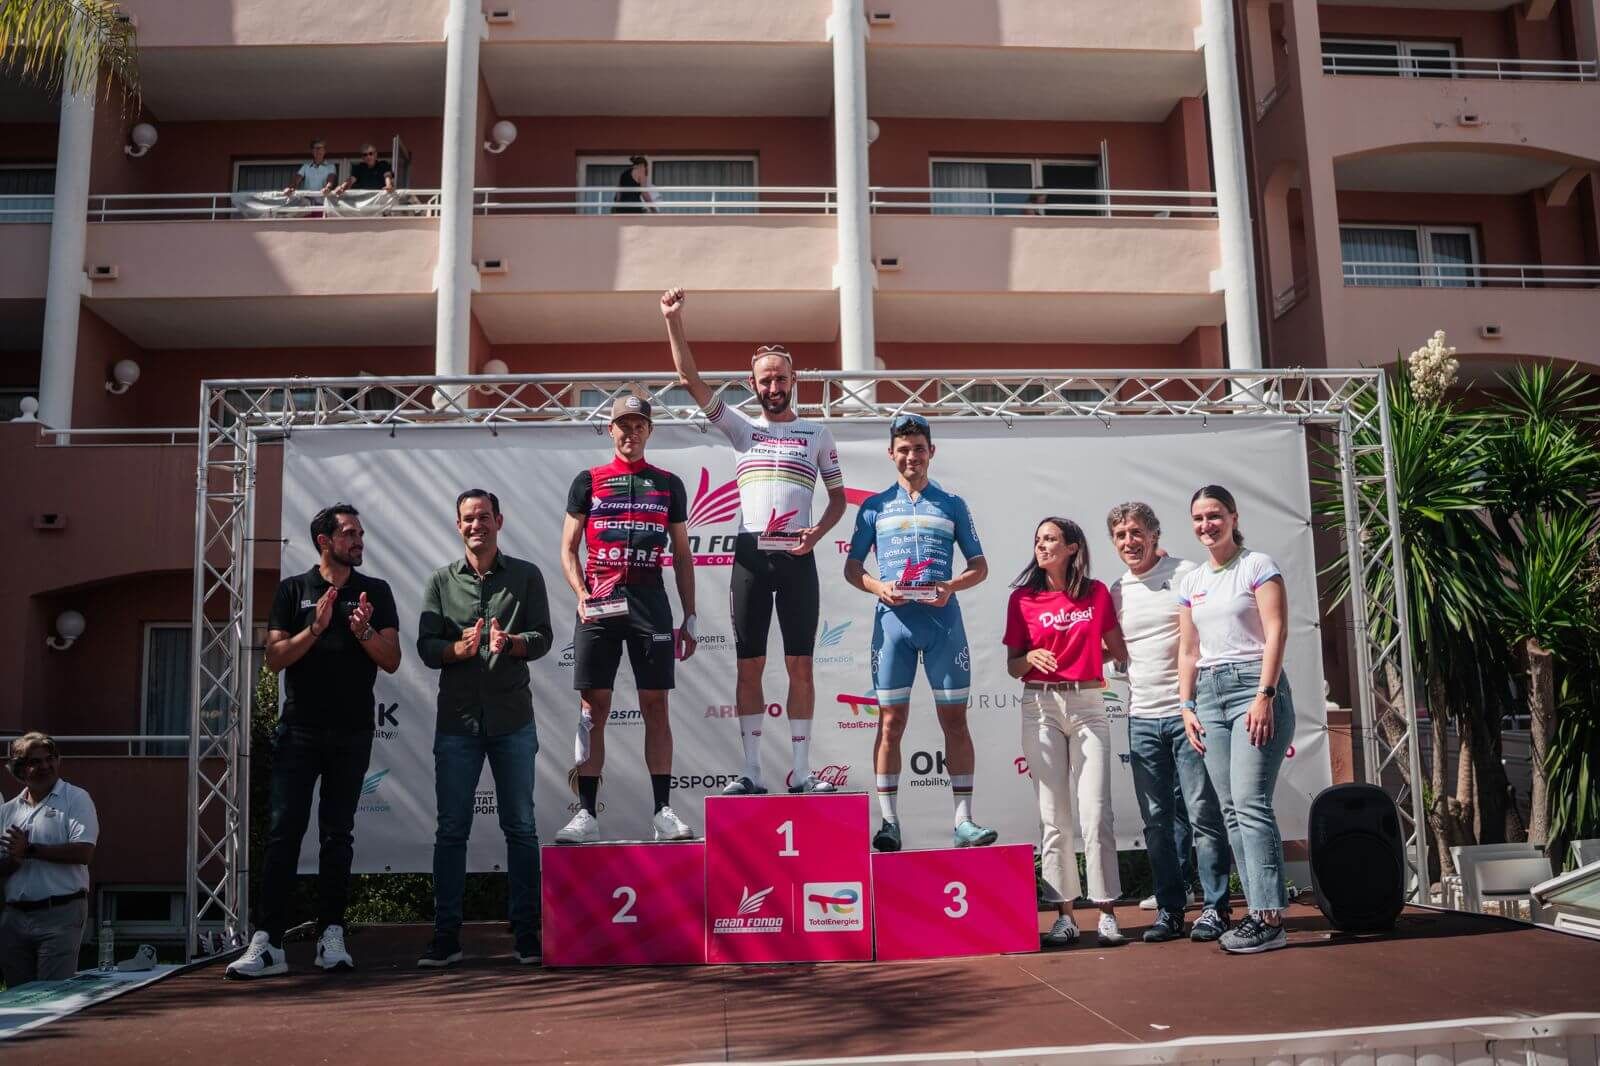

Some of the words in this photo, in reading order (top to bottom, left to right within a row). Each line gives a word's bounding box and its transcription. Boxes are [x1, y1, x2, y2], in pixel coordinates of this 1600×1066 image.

[594, 520, 665, 533] Giordana
[1039, 606, 1093, 628] Dulcesol
[776, 820, 800, 857] 1
[612, 886, 638, 923] 2
[943, 881, 969, 918] 3
[809, 917, 859, 927] TotalEnergies
